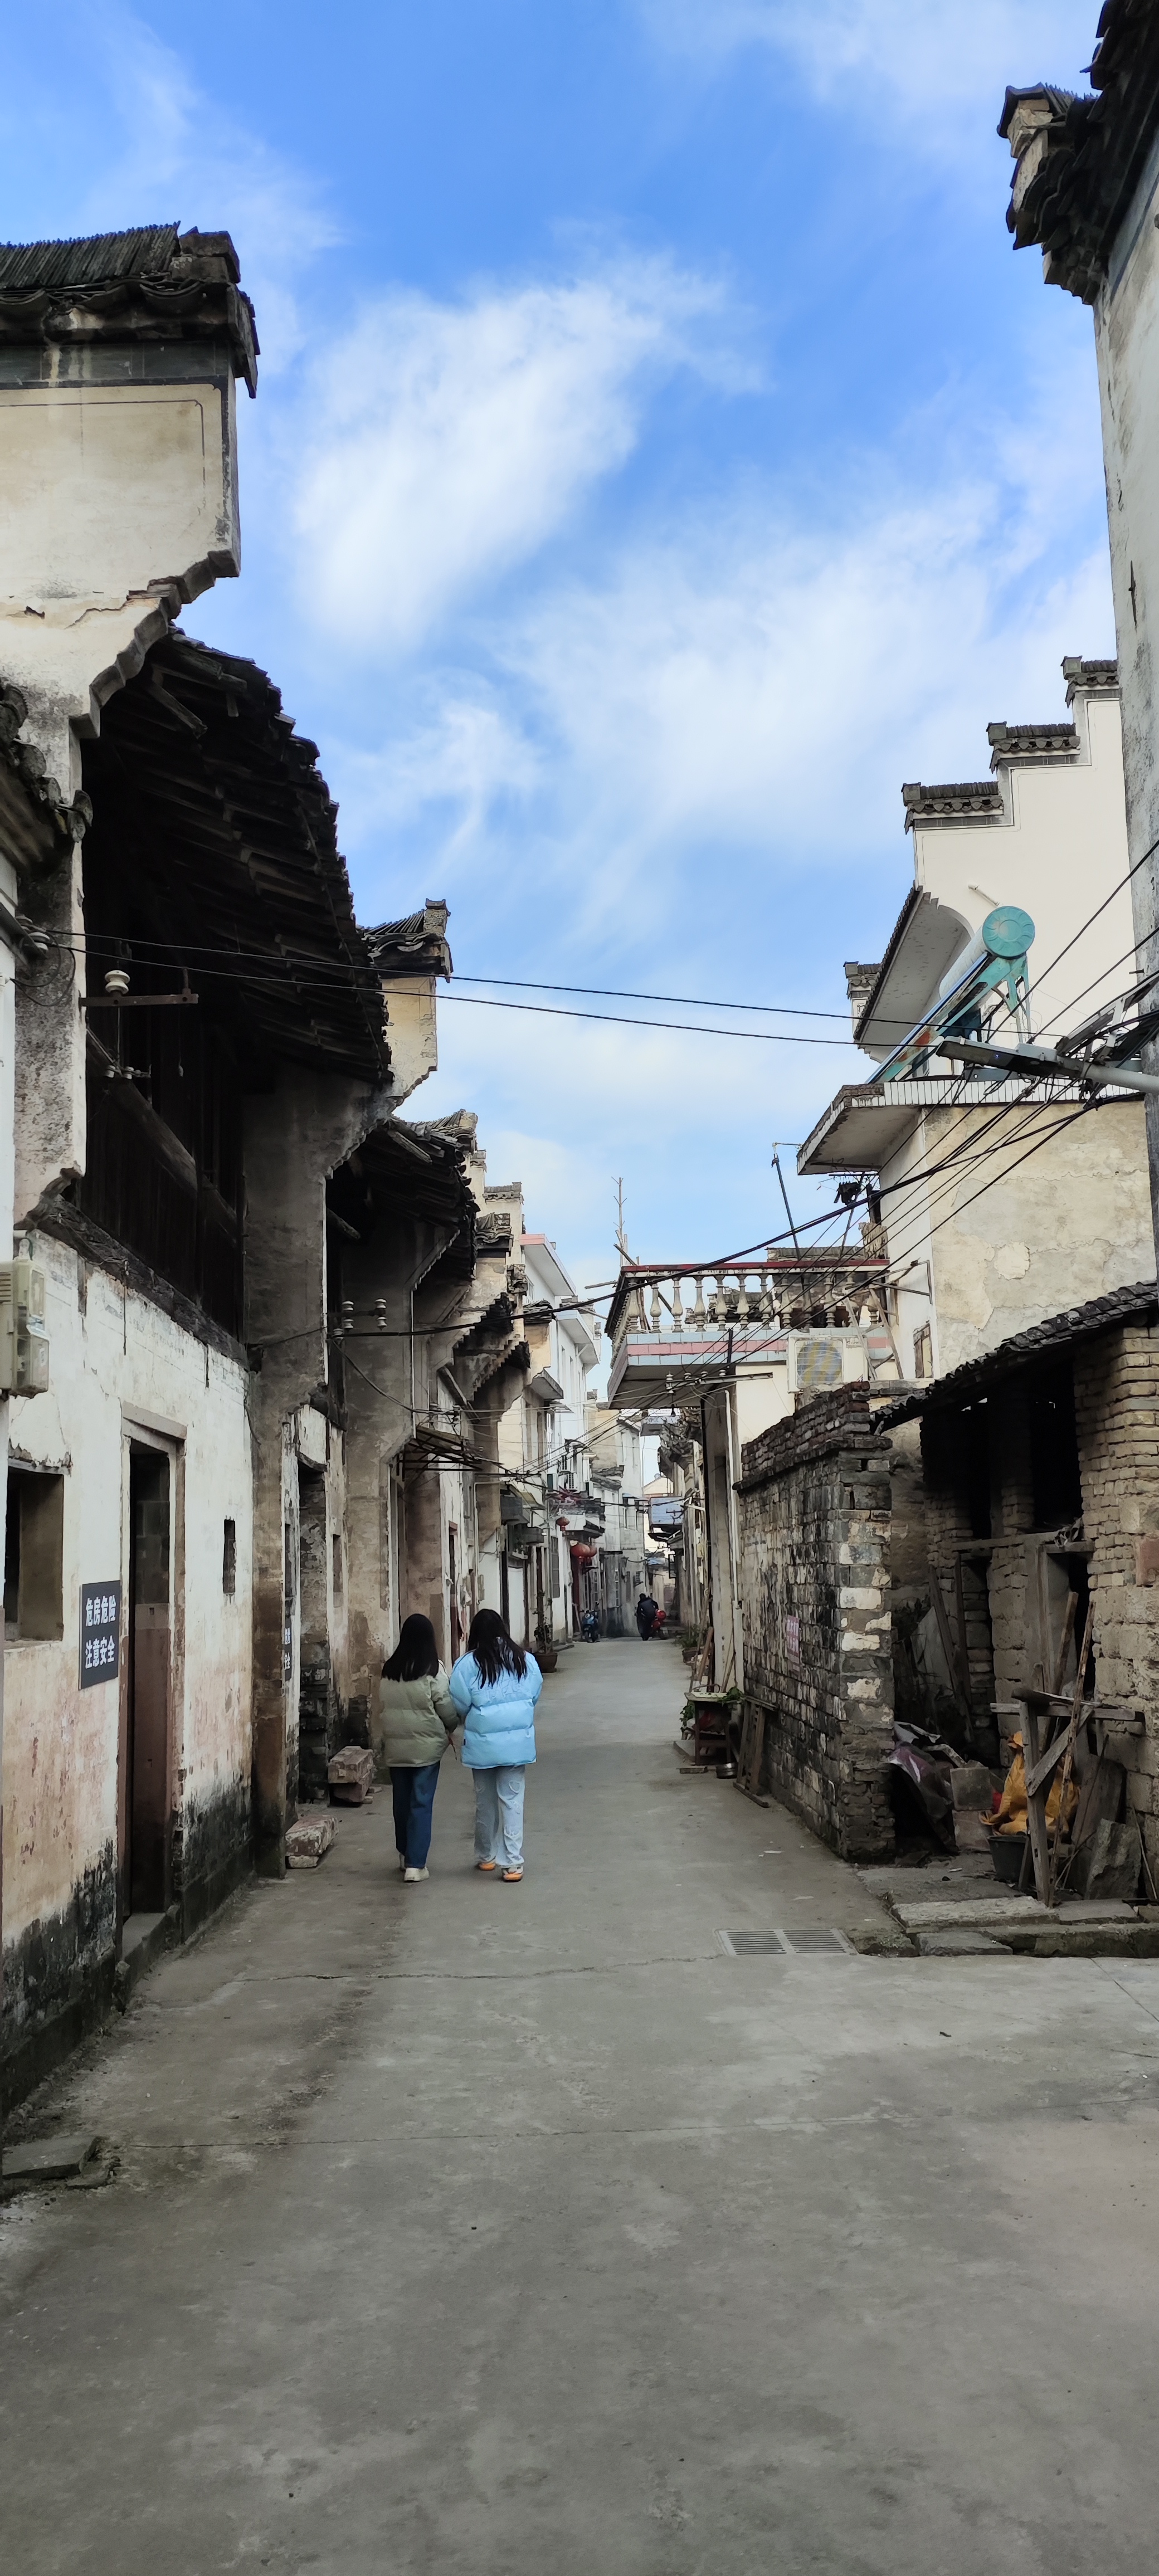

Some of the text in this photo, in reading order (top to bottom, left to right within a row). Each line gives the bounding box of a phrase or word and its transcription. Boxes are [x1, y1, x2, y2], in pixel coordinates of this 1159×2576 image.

[85, 1595, 116, 1627] 危房危险
[85, 1635, 115, 1669] 注意安全
